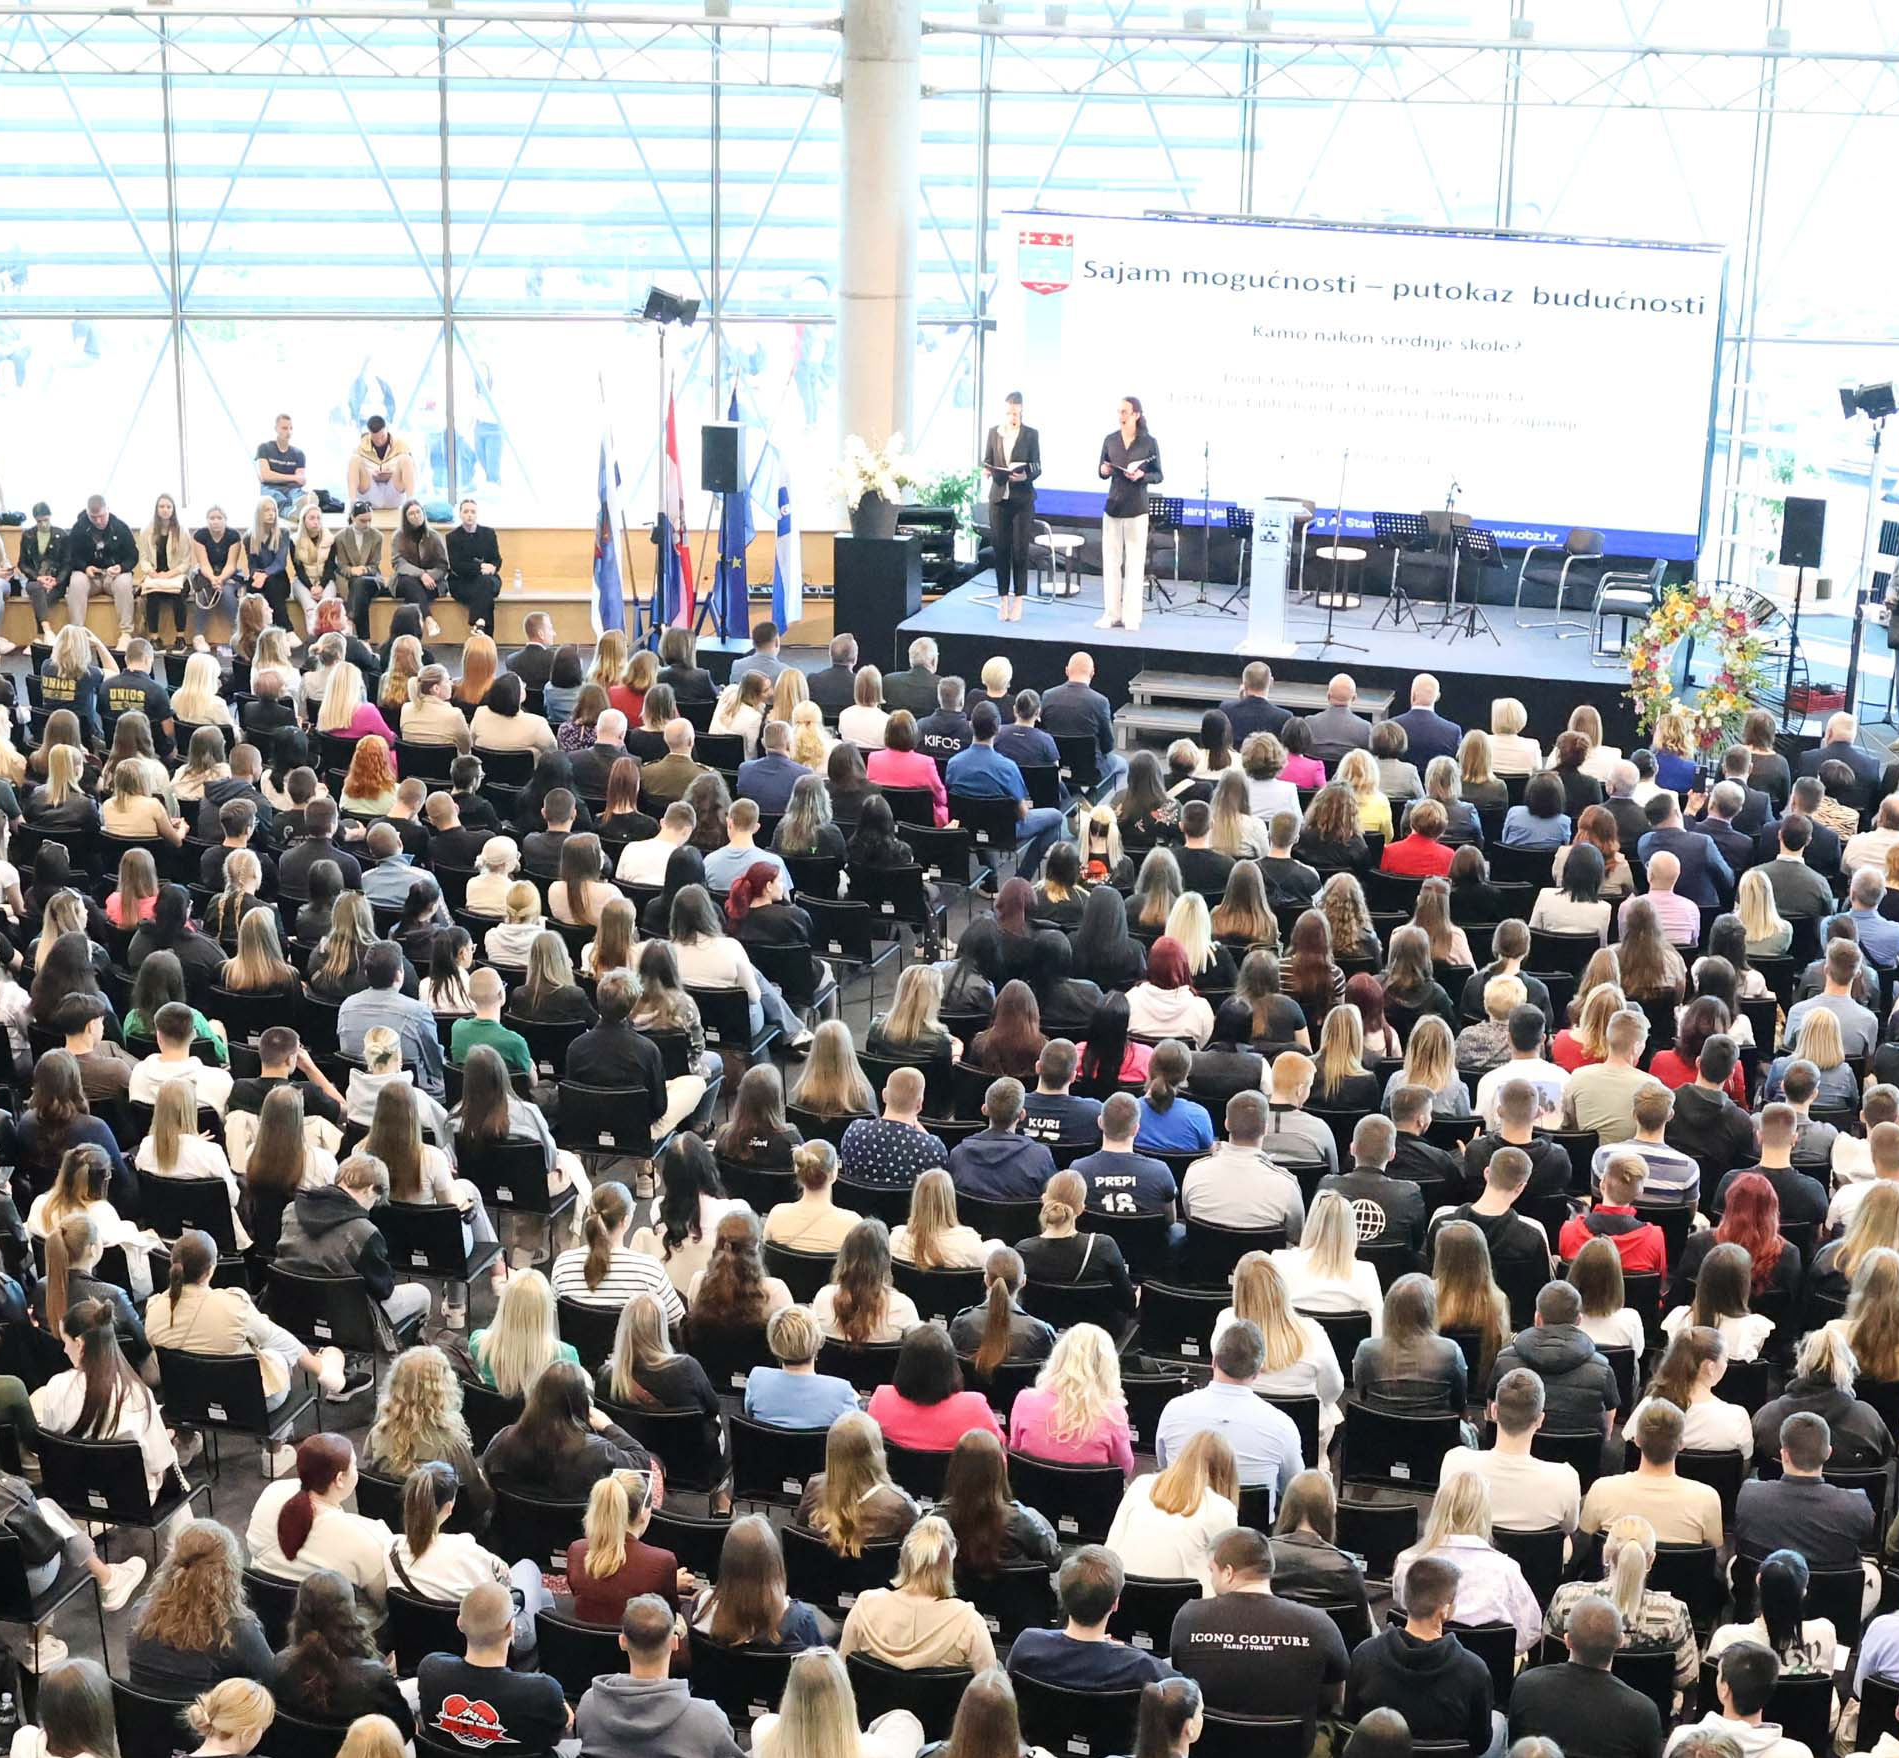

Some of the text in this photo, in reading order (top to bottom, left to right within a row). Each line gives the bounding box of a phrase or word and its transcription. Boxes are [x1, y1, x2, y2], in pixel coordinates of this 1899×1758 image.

[1083, 260, 1171, 284] Sajam
[1182, 270, 1356, 293] mogućnosti
[1393, 281, 1514, 303] putokaz
[1533, 285, 1705, 315] budućnosti
[1252, 325, 1308, 341] Kamo
[1315, 327, 1374, 345] nakon
[1381, 335, 1453, 352] srednje
[1492, 530, 1558, 542] ww.obz.hr
[42, 676, 77, 691] UNIOS
[109, 688, 146, 701] UNIOS
[924, 734, 961, 750] KIFOS
[1028, 1117, 1061, 1130] KURI
[1095, 1176, 1137, 1188] PREPI
[1190, 1633, 1311, 1648] ICONO COUTURE
[1222, 1643, 1244, 1651] PARIS
[1249, 1644, 1275, 1652] TOKYO
